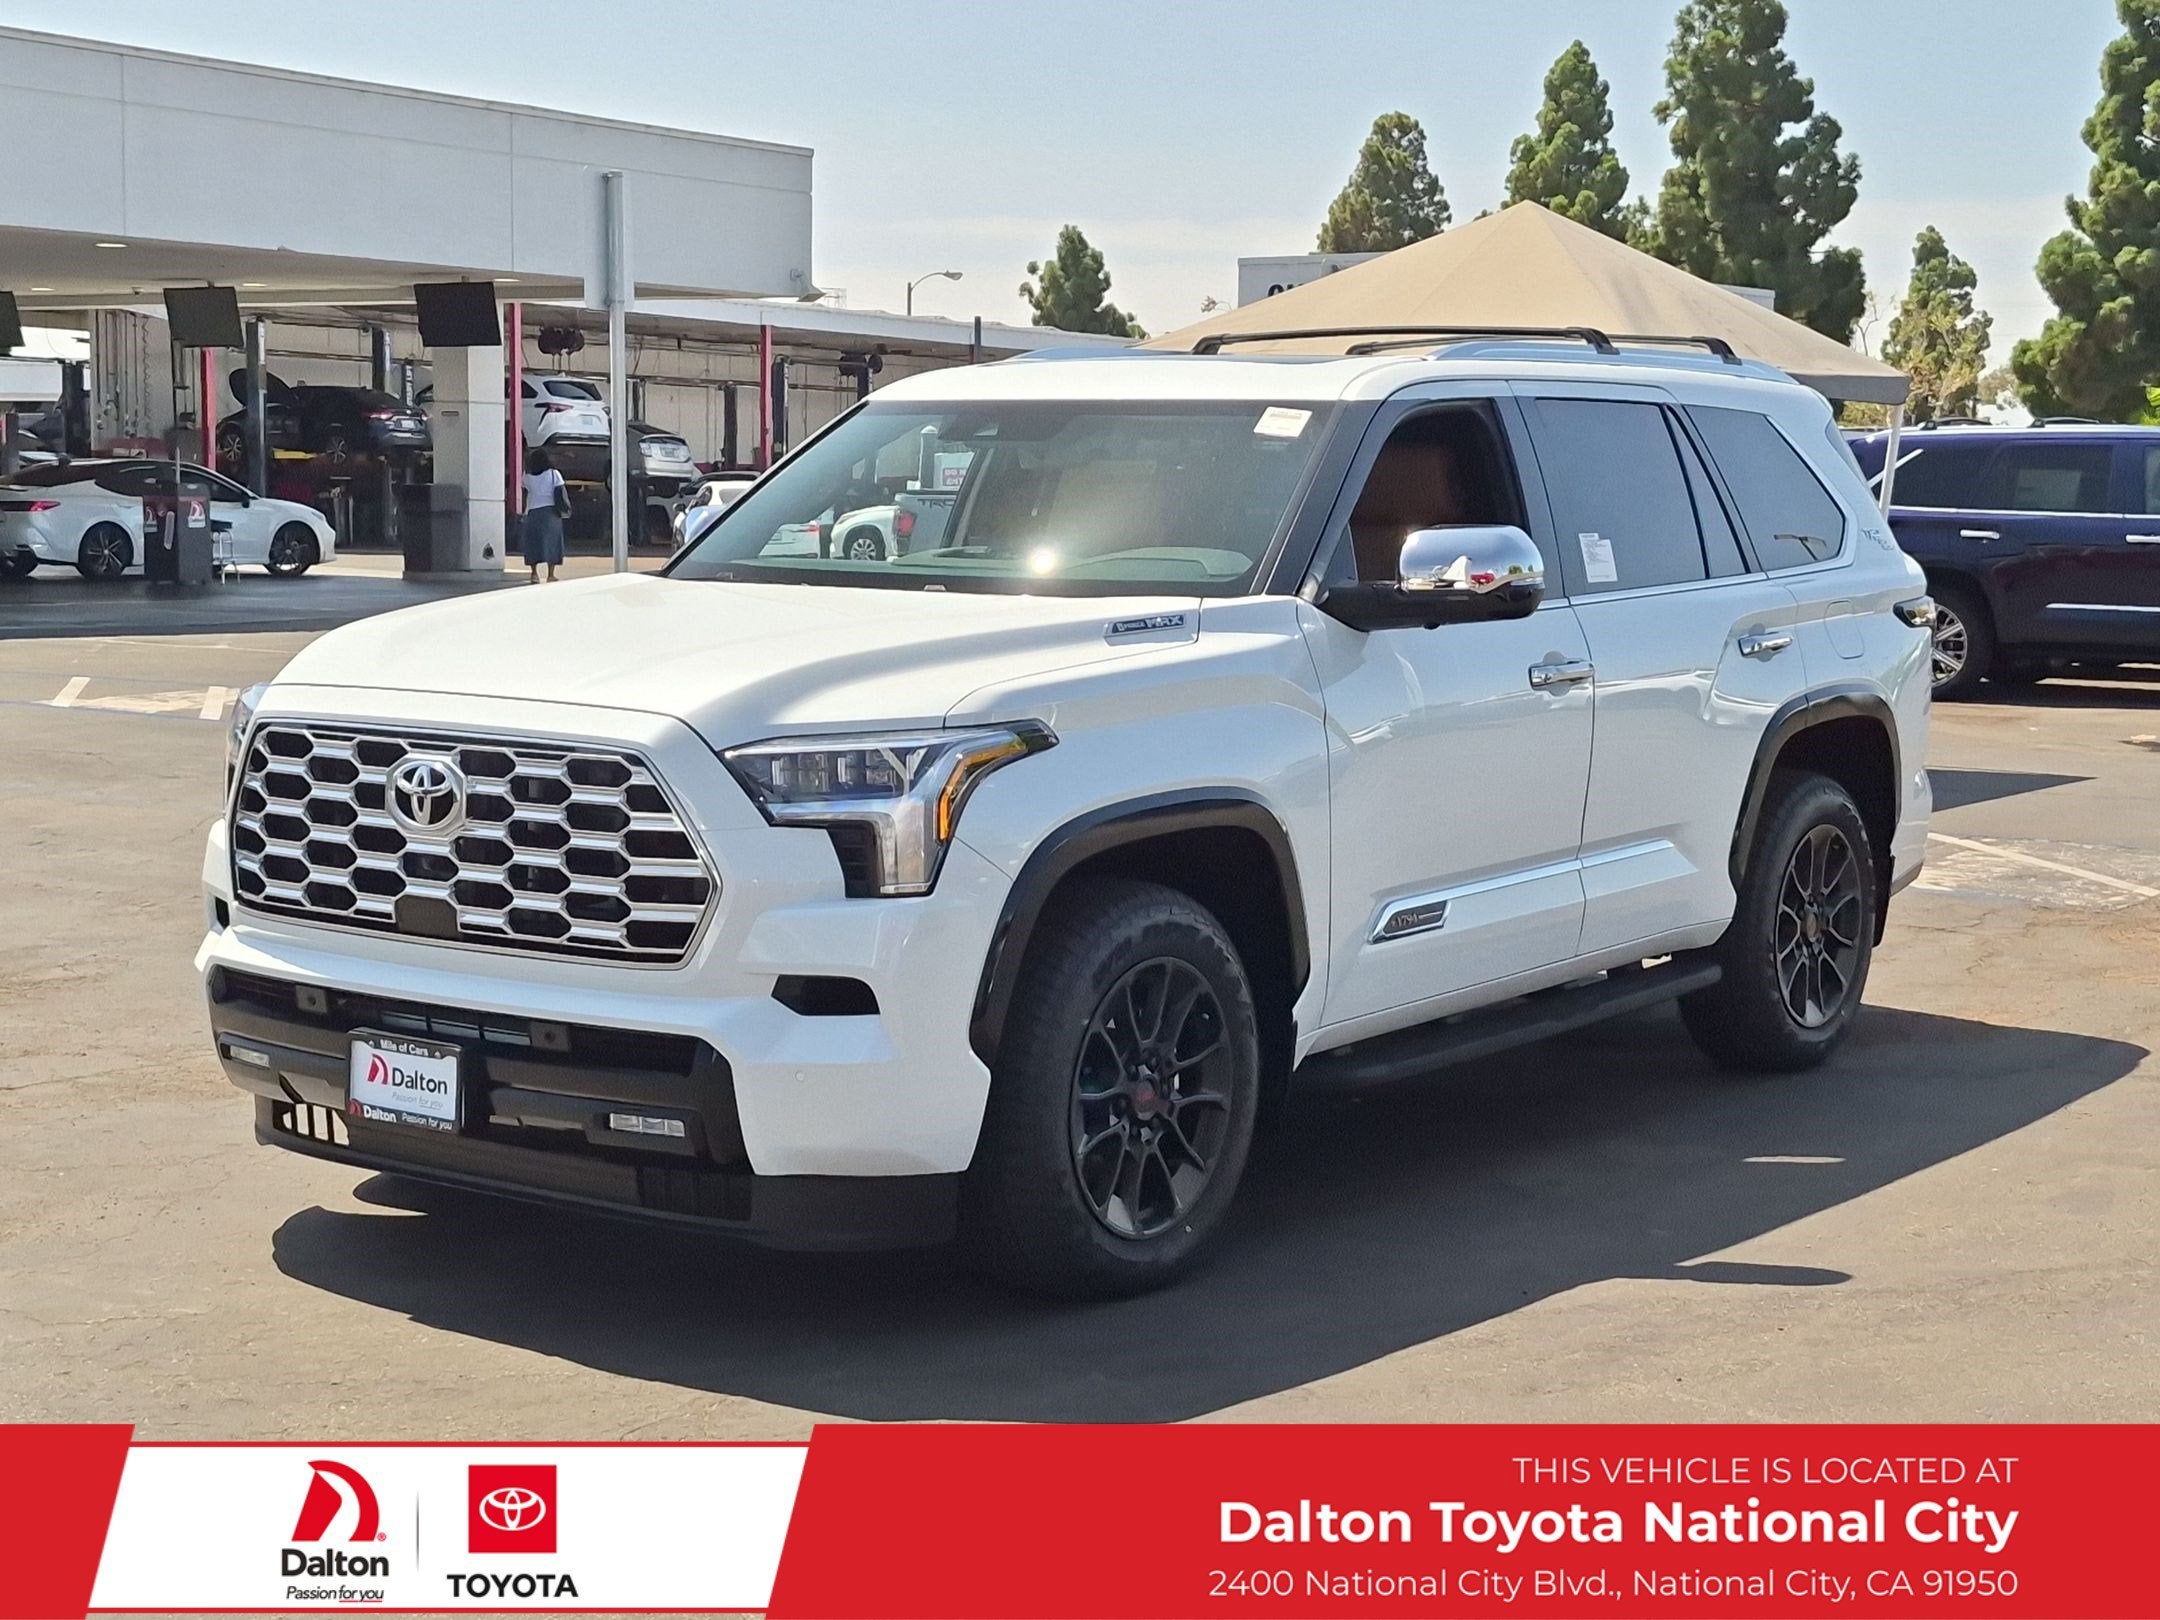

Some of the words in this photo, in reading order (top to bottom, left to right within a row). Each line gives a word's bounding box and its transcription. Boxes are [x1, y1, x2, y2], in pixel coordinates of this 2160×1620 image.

[380, 1039, 397, 1051] Mile
[398, 1043, 407, 1052] of
[408, 1044, 429, 1056] Cars
[392, 1067, 448, 1095] Dalton
[392, 1091, 417, 1103] Passion
[418, 1096, 430, 1106] for
[430, 1100, 444, 1110] you
[363, 1105, 397, 1123] Dalton
[402, 1112, 427, 1125] Passion
[428, 1117, 438, 1127] for
[439, 1121, 453, 1130] you
